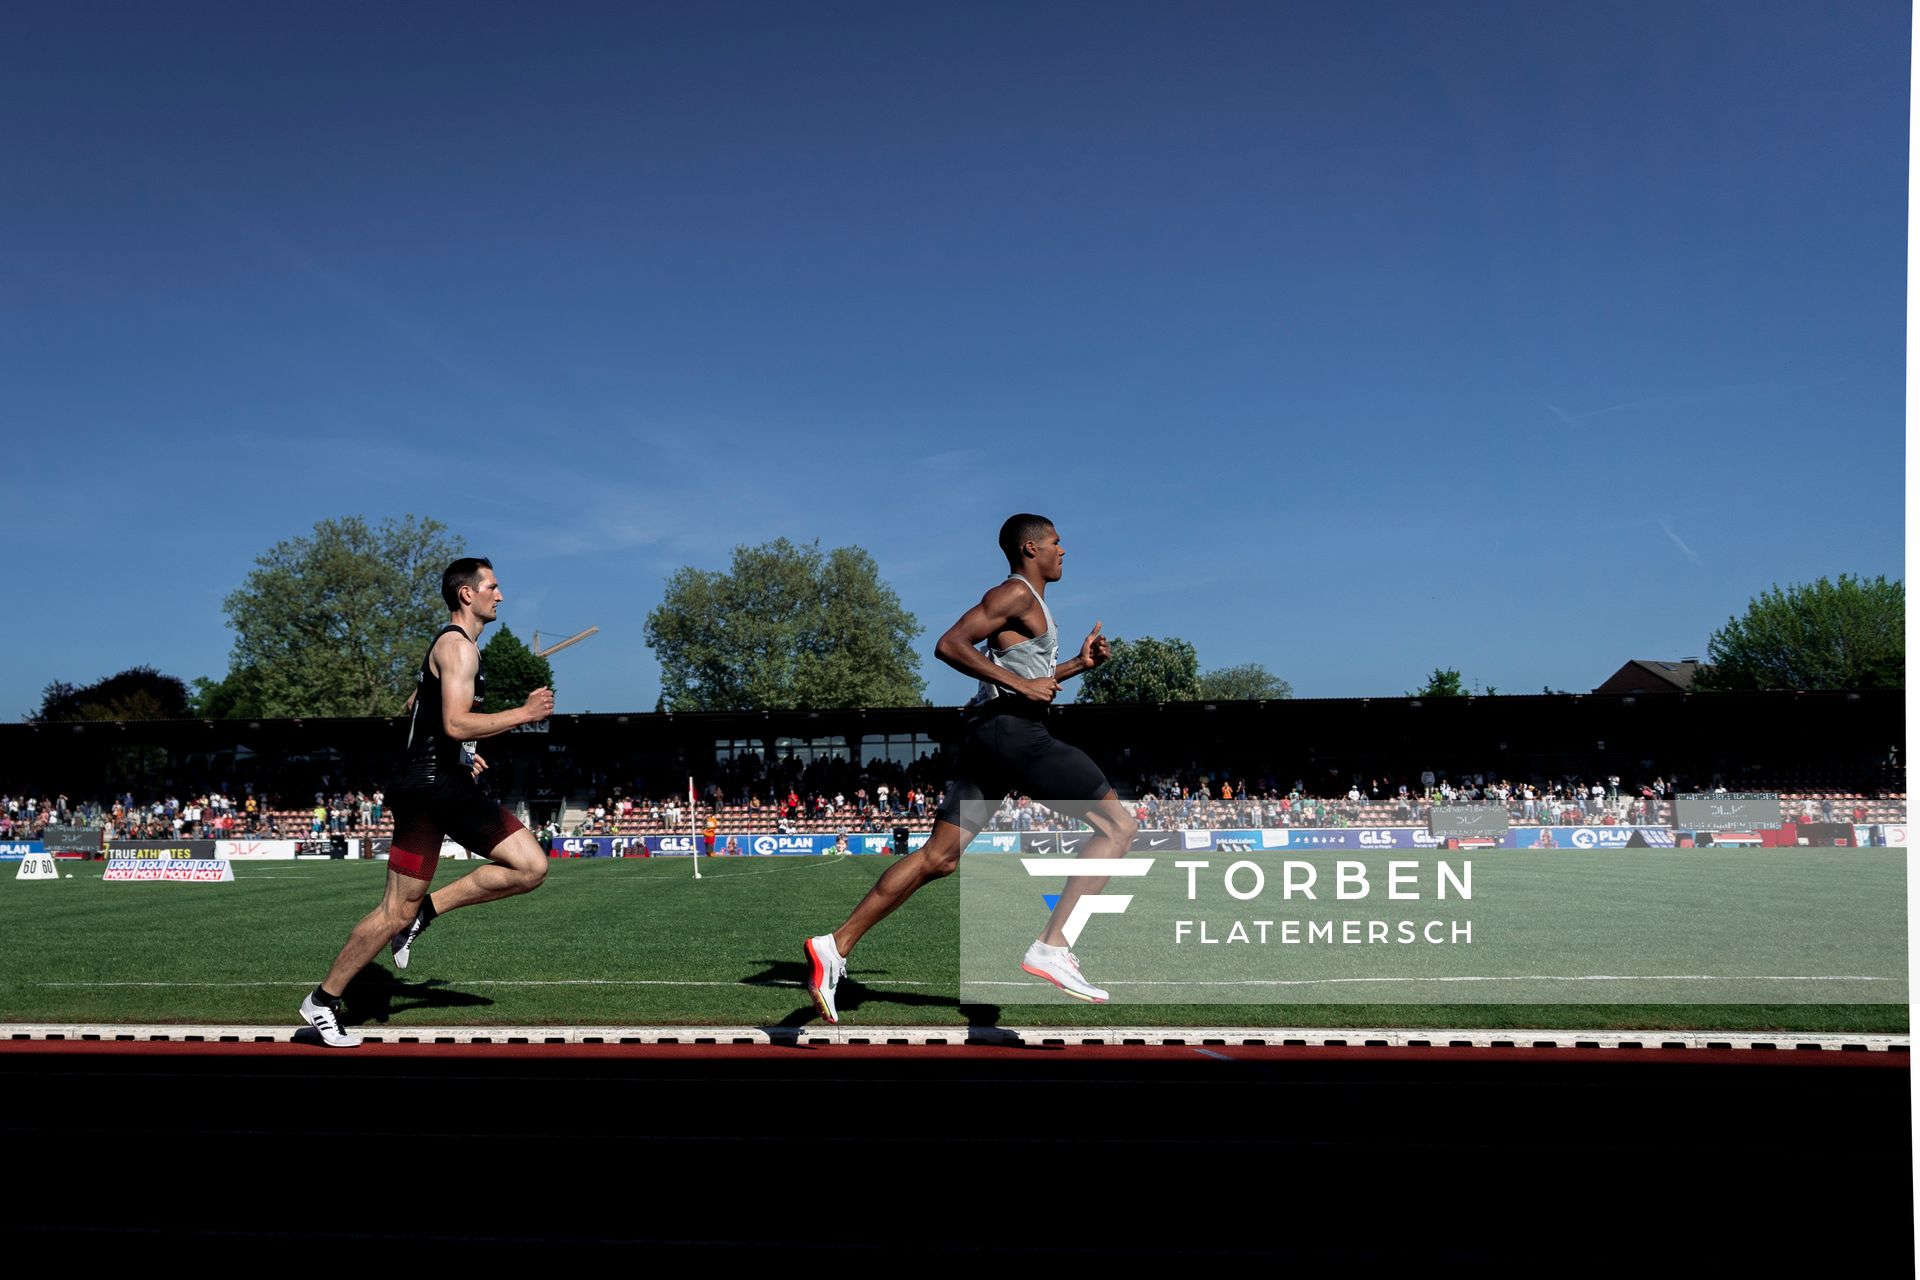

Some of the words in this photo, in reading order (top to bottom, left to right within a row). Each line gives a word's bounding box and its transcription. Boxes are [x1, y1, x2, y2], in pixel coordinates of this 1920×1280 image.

[779, 837, 813, 848] PLAN
[1359, 831, 1397, 844] GLS.
[0, 844, 30, 854] PLAN
[23, 860, 37, 873] 60
[42, 860, 53, 873] 60
[110, 860, 137, 870] LIQUI
[138, 860, 166, 870] LIQUI
[167, 860, 195, 870] LIQUI
[197, 860, 225, 870] LIQUI
[105, 870, 133, 879] MOLY
[135, 870, 162, 879] MOLY
[164, 870, 191, 879] MOLY
[194, 870, 222, 879] MOLY
